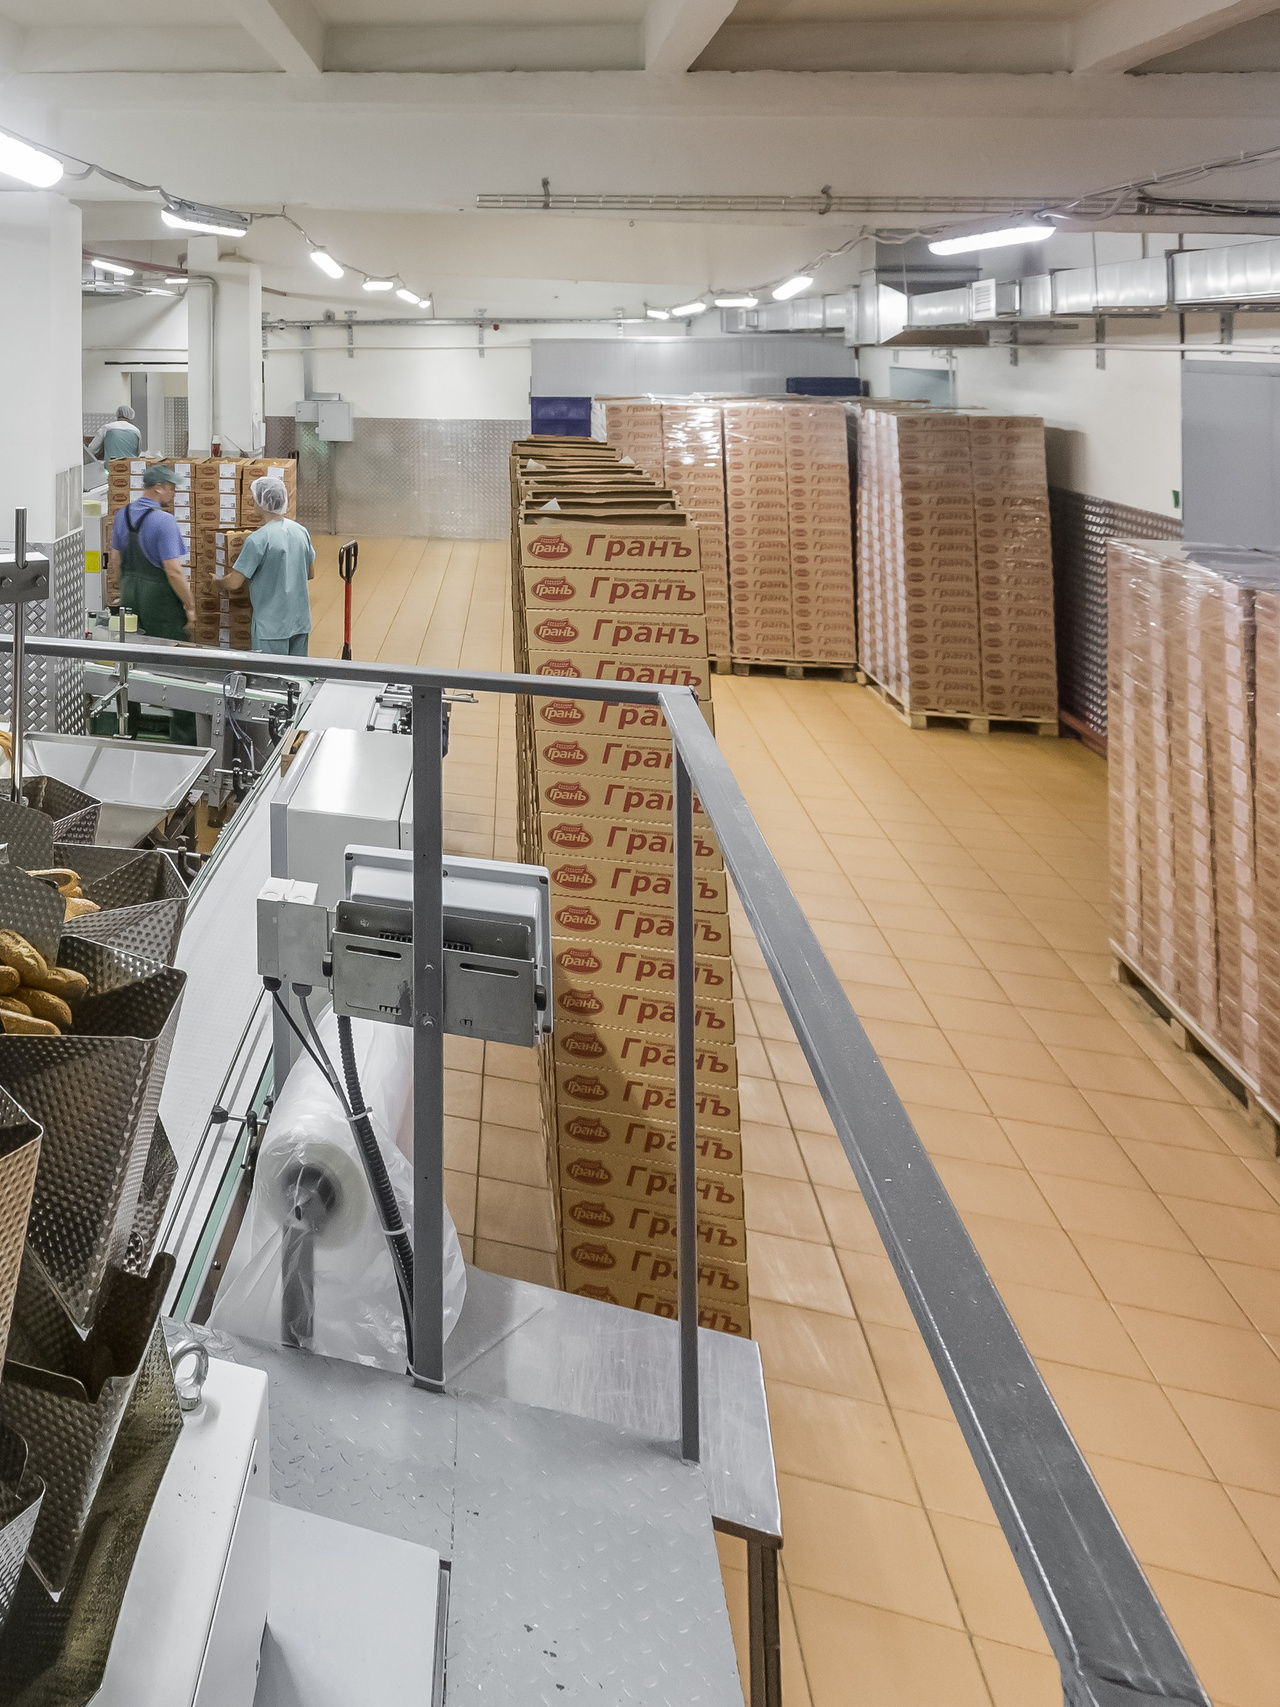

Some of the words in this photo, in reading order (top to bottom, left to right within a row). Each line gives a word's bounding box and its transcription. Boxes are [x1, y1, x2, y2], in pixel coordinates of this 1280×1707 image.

[587, 535, 692, 561] Гранъ
[590, 577, 696, 604] Гранъ
[593, 619, 699, 646] Гранъ
[617, 619, 660, 627] Кондитерская
[599, 702, 670, 729] Гра
[603, 743, 673, 771] Гра
[607, 826, 714, 857] Граъ
[611, 868, 718, 900] Граъ
[615, 910, 721, 942] Граъ
[629, 1208, 738, 1248] Грнъ
[631, 1250, 740, 1291] Грнъ
[634, 1291, 742, 1334] Грнъ
